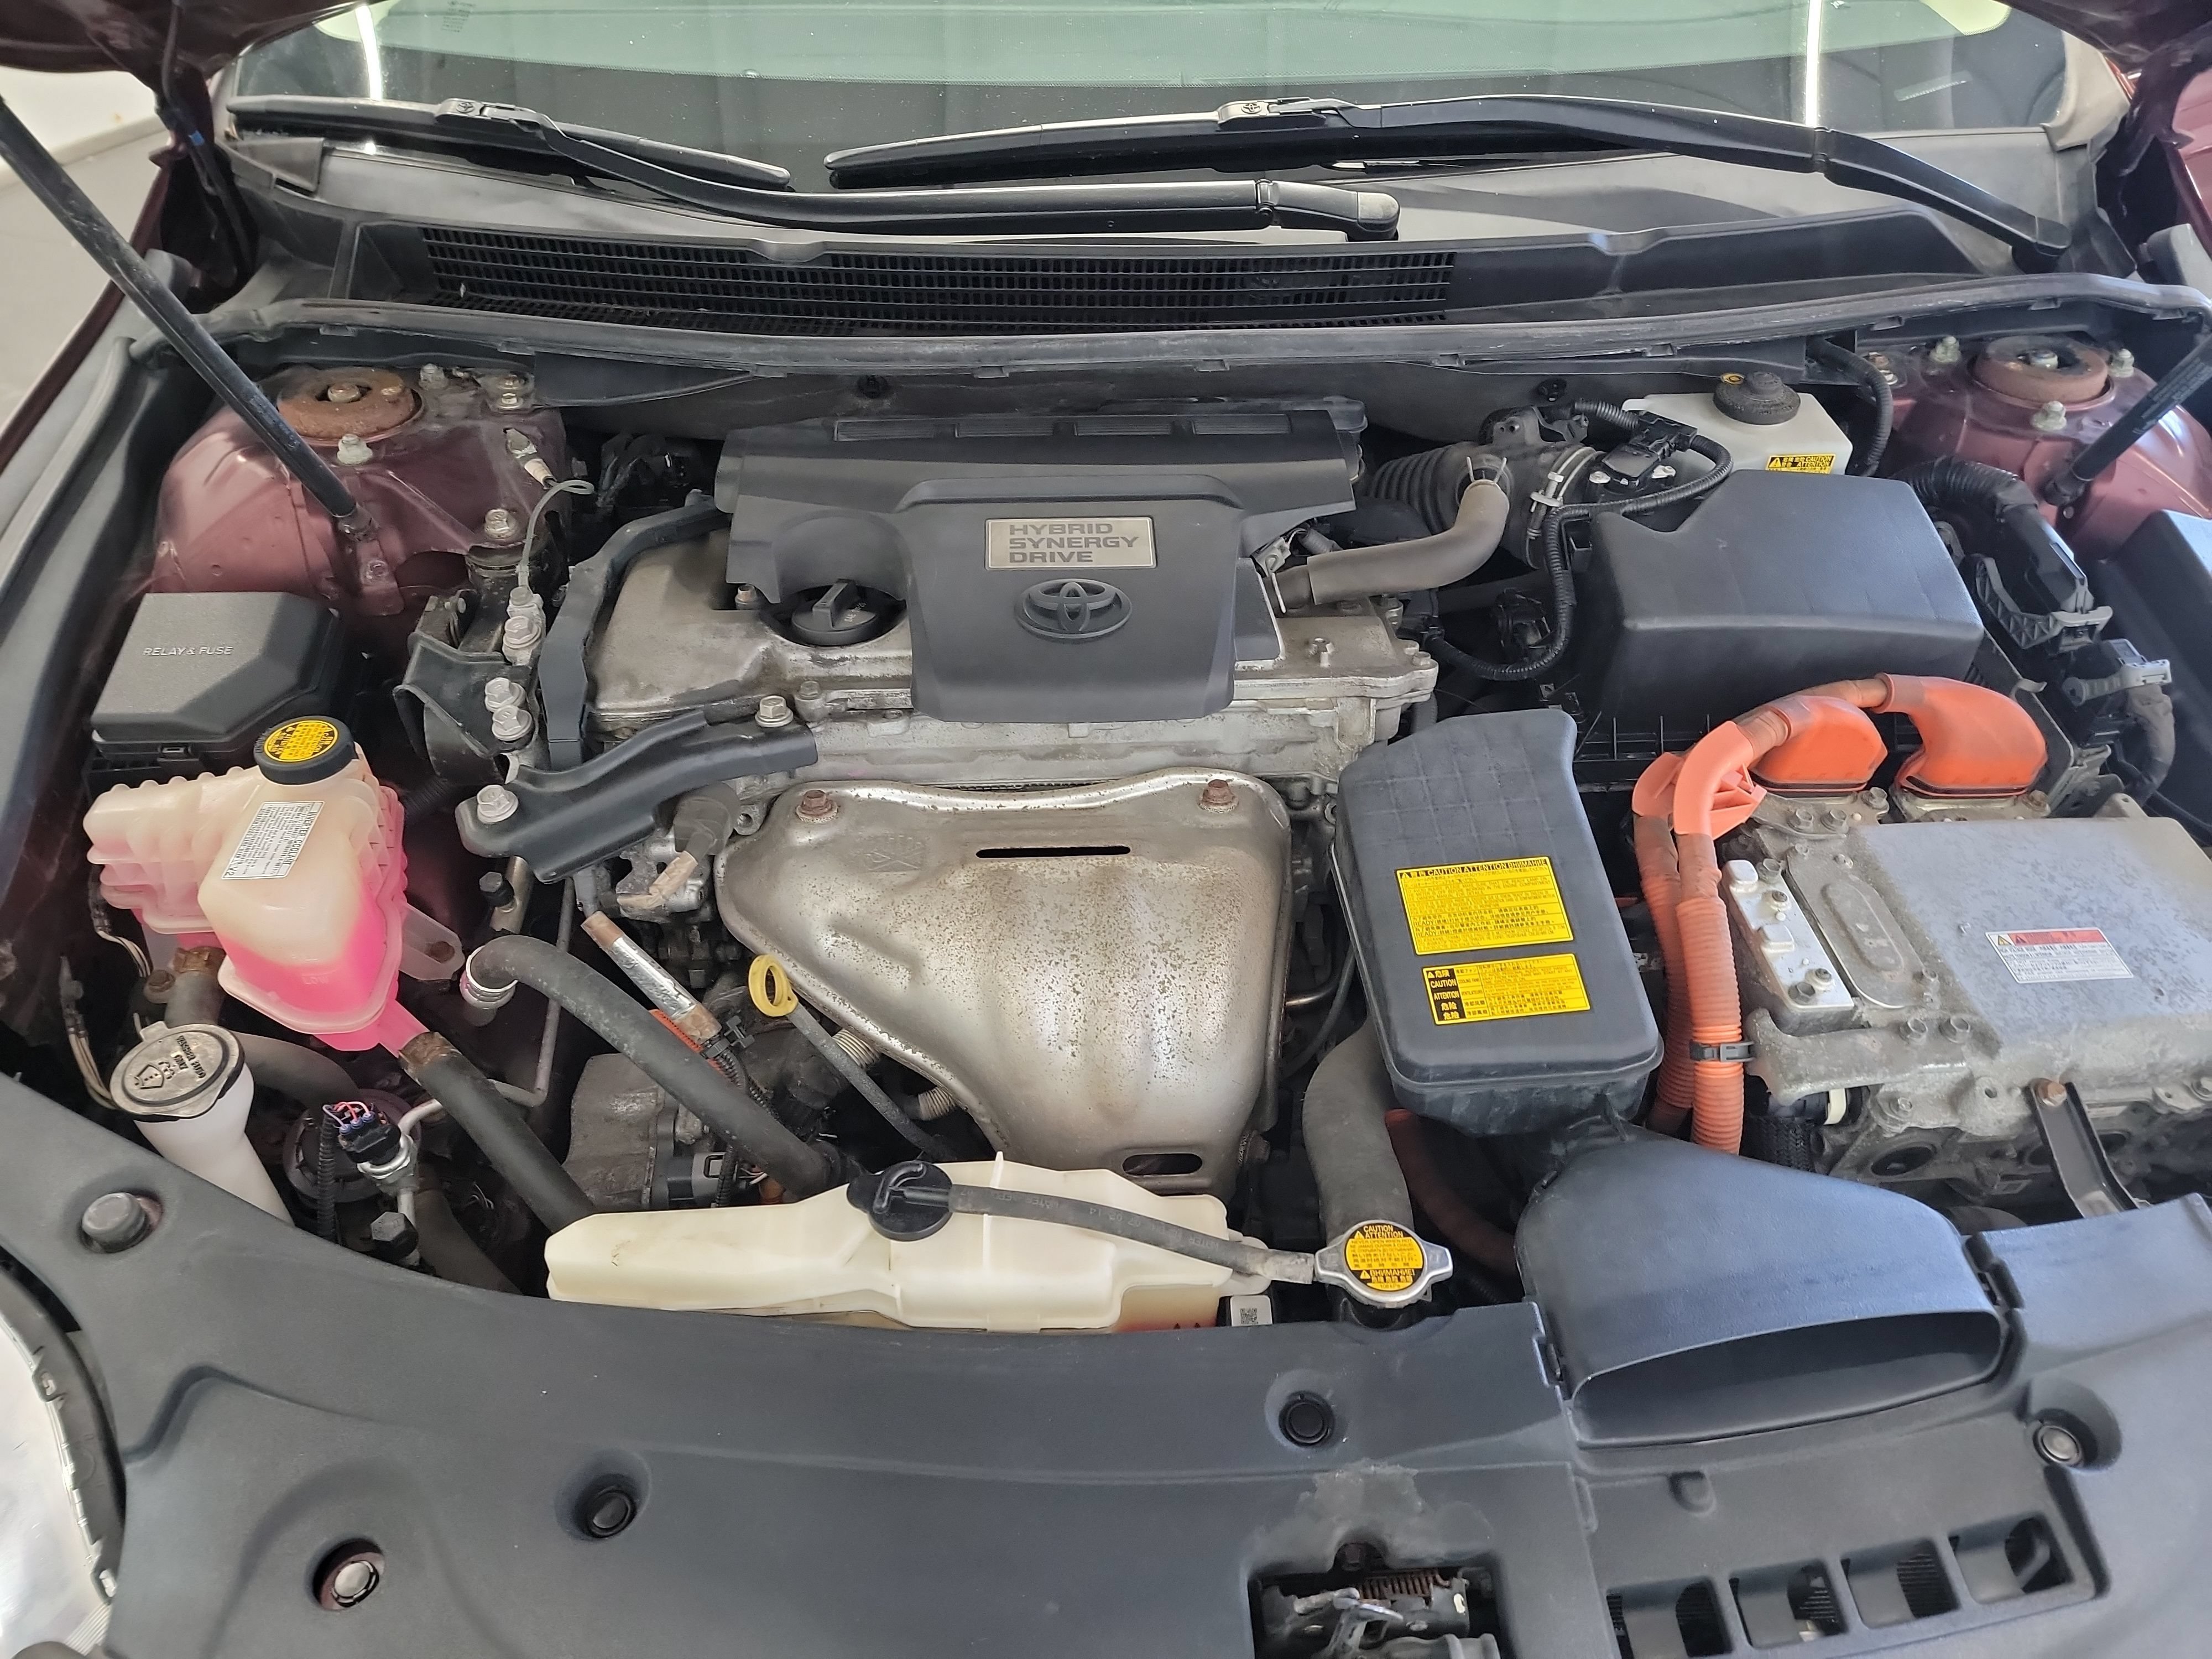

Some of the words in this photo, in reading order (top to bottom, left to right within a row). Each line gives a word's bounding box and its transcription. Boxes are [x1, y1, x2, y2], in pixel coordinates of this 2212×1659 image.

[1009, 523, 1113, 535] HYBRID
[1009, 536, 1139, 549] SYNERGY
[1009, 551, 1093, 563] DRIVE
[143, 647, 186, 656] RELAY
[186, 647, 195, 655] &
[199, 646, 233, 655] FUSE
[297, 812, 319, 837] INVERTER
[283, 839, 303, 865] COOLANT
[1427, 867, 1462, 876] CAUTION
[1464, 863, 1507, 873] ATTENTION
[1508, 859, 1547, 869] ВНИМАНИЕ
[225, 866, 238, 876] V2
[1430, 978, 1457, 989] CAUTION
[1433, 990, 1460, 1000] ATTENTION
[1365, 1231, 1404, 1239] ATTENTION
